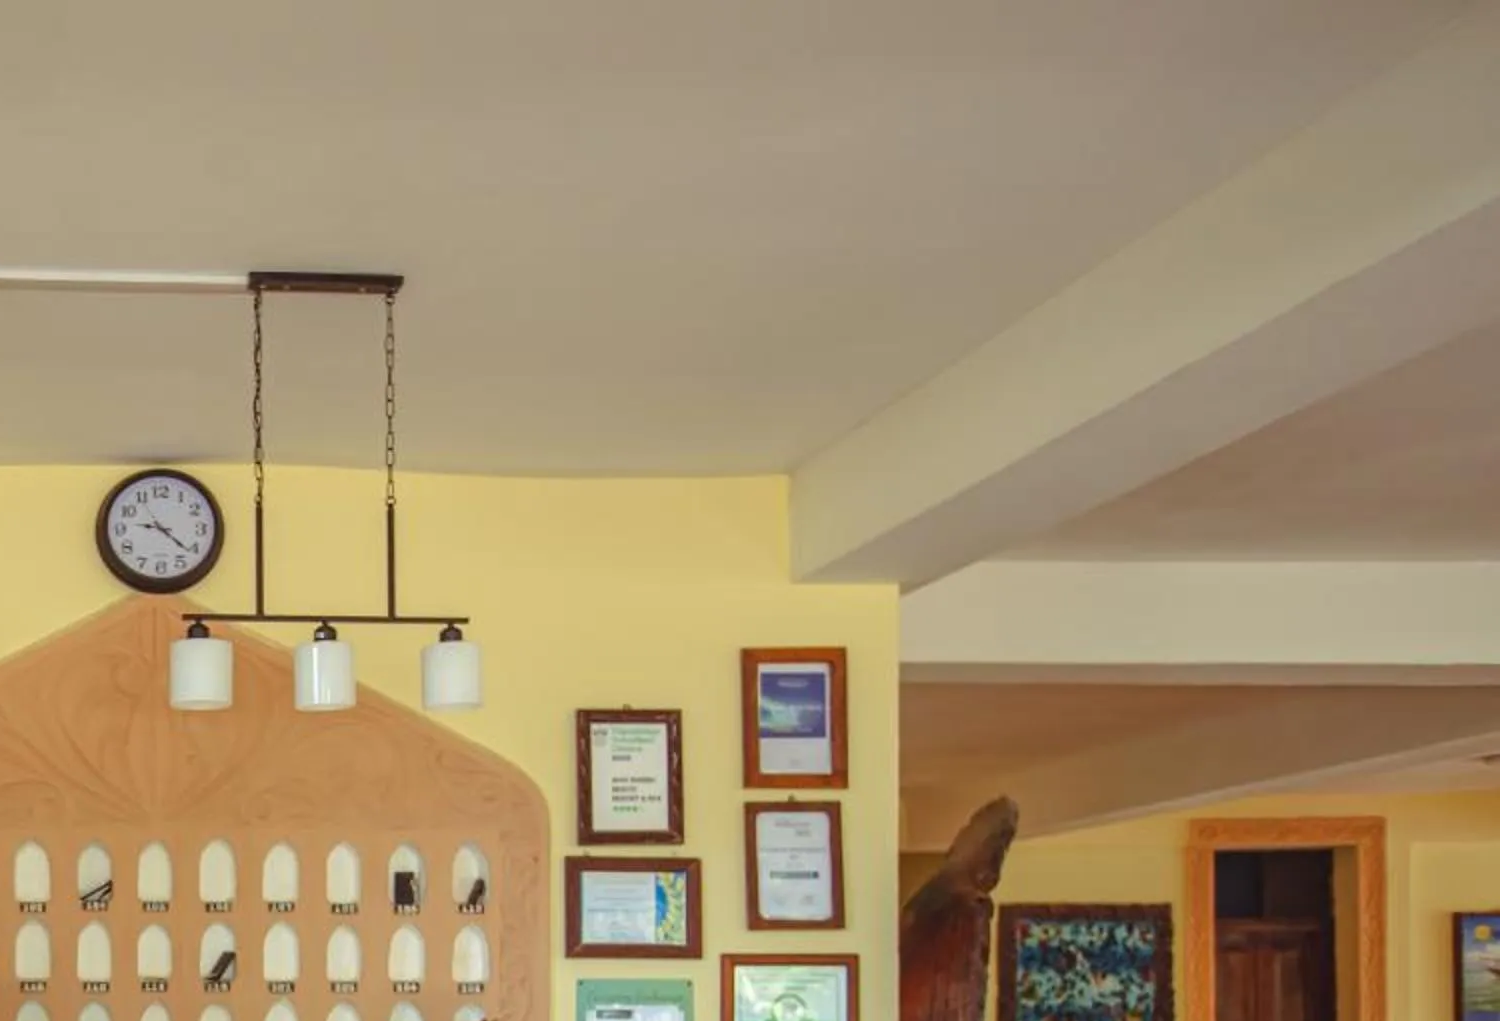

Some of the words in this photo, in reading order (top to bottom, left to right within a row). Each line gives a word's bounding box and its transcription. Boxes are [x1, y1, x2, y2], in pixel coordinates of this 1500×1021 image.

[137, 491, 148, 504] 11
[152, 485, 169, 499] 12
[121, 505, 136, 517] 10
[189, 502, 201, 517] 2
[195, 522, 207, 536] 3
[136, 556, 147, 569] 7
